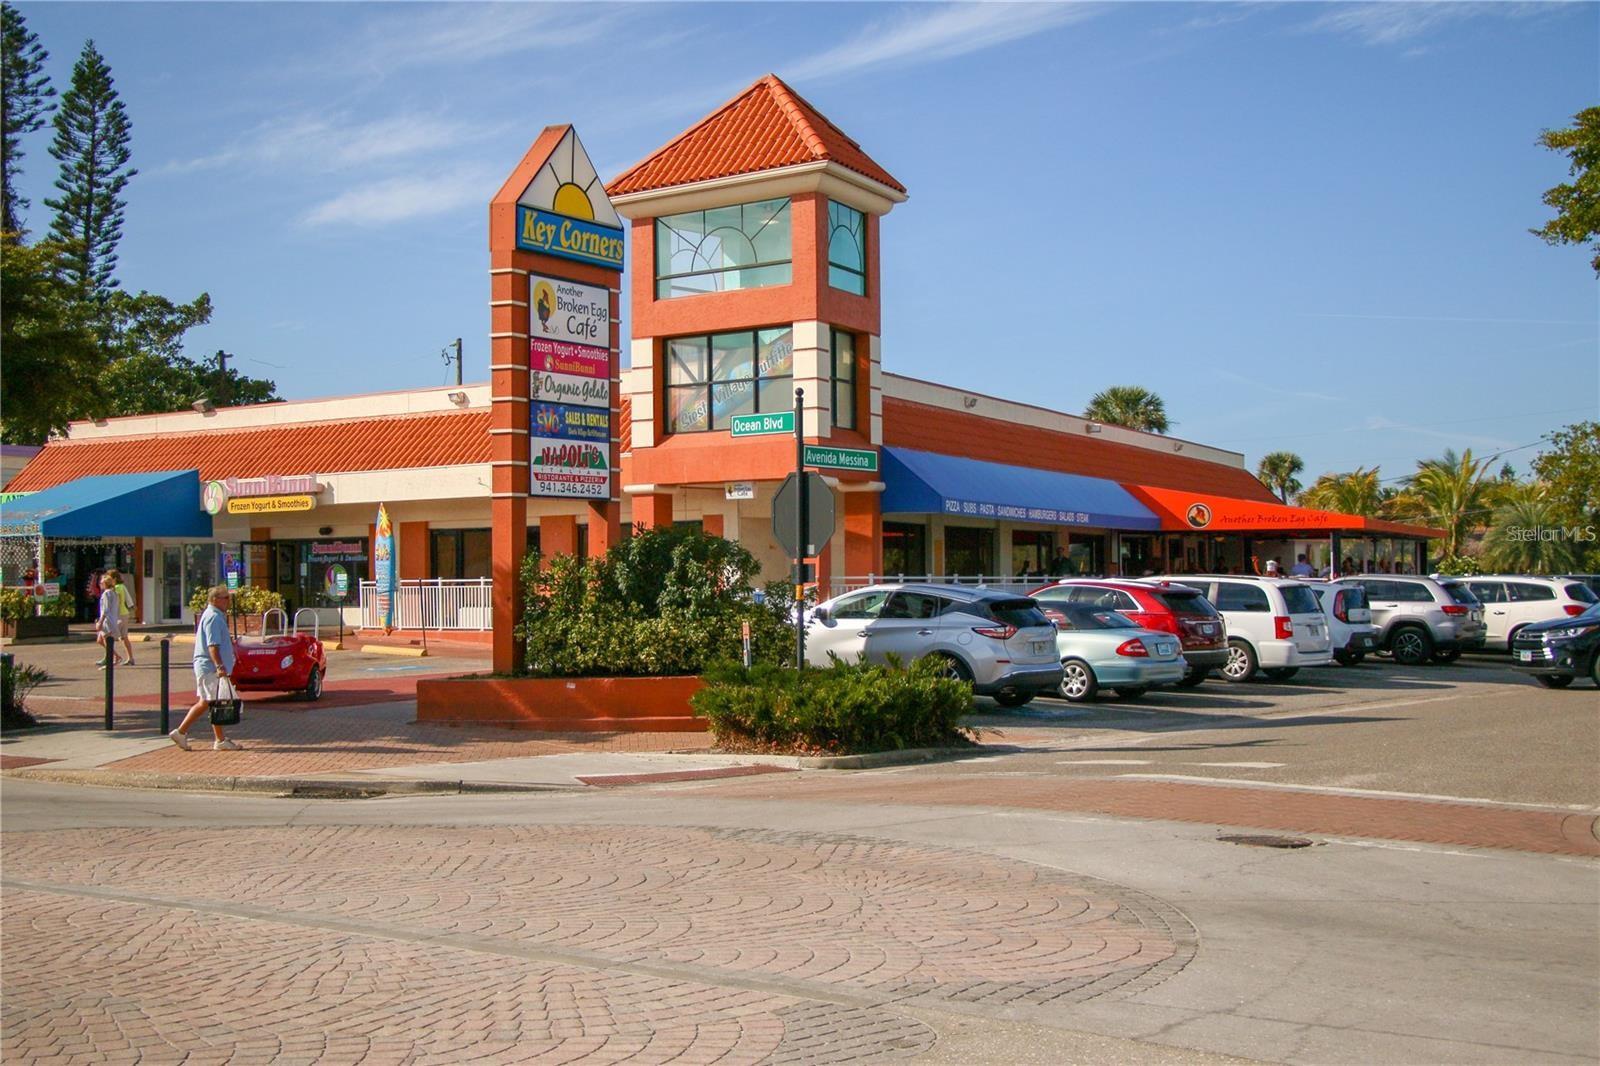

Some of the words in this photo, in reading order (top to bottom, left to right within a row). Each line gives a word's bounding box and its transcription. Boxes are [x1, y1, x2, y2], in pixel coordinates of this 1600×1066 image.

[523, 210, 556, 249] Key
[560, 220, 623, 259] Corners
[557, 285, 583, 297] Another
[557, 296, 589, 315] Broken
[591, 302, 607, 322] Egg
[567, 315, 597, 339] Café
[530, 339, 553, 352] Frozen
[553, 342, 574, 358] Yogurt
[578, 346, 608, 361] Smoothies
[544, 375, 581, 400] Organic
[565, 411, 581, 425] SALES
[587, 413, 609, 428] RENTALS
[734, 419, 761, 432] Ocean
[763, 417, 783, 430] Blvd
[806, 450, 838, 464] Avenida
[839, 453, 869, 467] Messina
[537, 474, 574, 482] RISTORANTE
[580, 476, 604, 484] PIZZERIA
[540, 482, 602, 495] 941.346.2452
[230, 502, 250, 510] Frozen
[251, 500, 271, 511] Yogurt
[271, 500, 276, 508] &
[277, 499, 309, 508] Smoothies
[945, 500, 960, 512] PIZZA
[963, 502, 977, 513] SUBS
[980, 504, 995, 515] PASTA
[998, 505, 1026, 519] SANDWICHES
[1029, 509, 1057, 520] HAMBURGERS
[1220, 513, 1254, 524] Another
[1257, 512, 1288, 523] Broken
